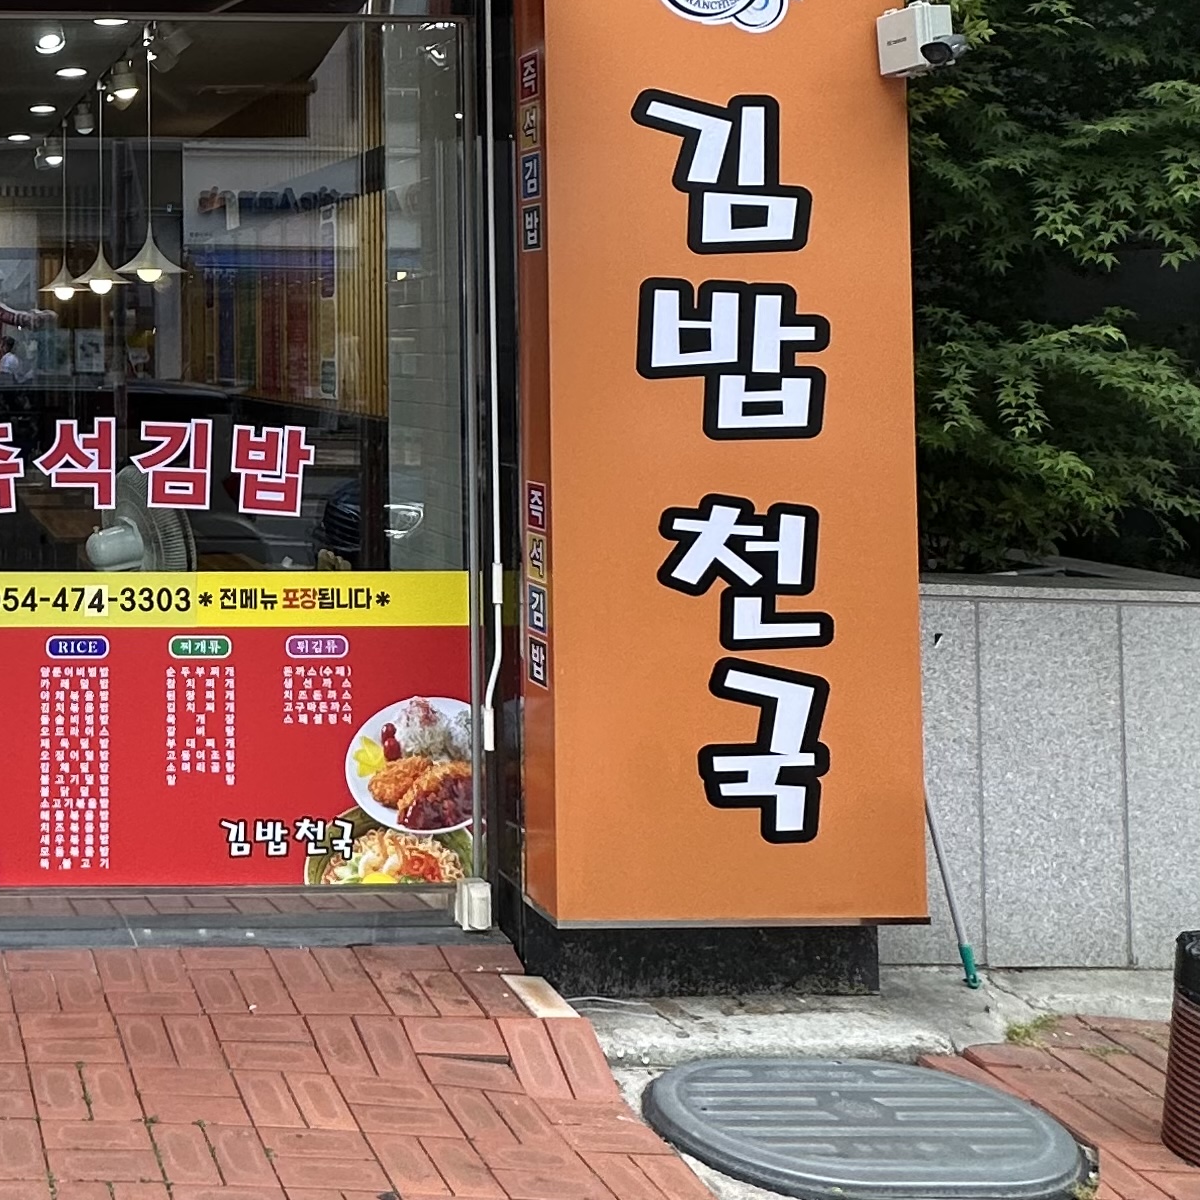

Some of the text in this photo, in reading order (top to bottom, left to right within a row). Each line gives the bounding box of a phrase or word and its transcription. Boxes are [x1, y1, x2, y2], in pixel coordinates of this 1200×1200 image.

[631, 88, 835, 844] 김밥천국
[219, 587, 278, 610] 전메뉴
[282, 587, 373, 610] 포장됩니다
[57, 640, 99, 654] RICE
[179, 639, 222, 654] 찌개류
[296, 639, 339, 654] 튀김류
[218, 816, 354, 859] 김밥천국
